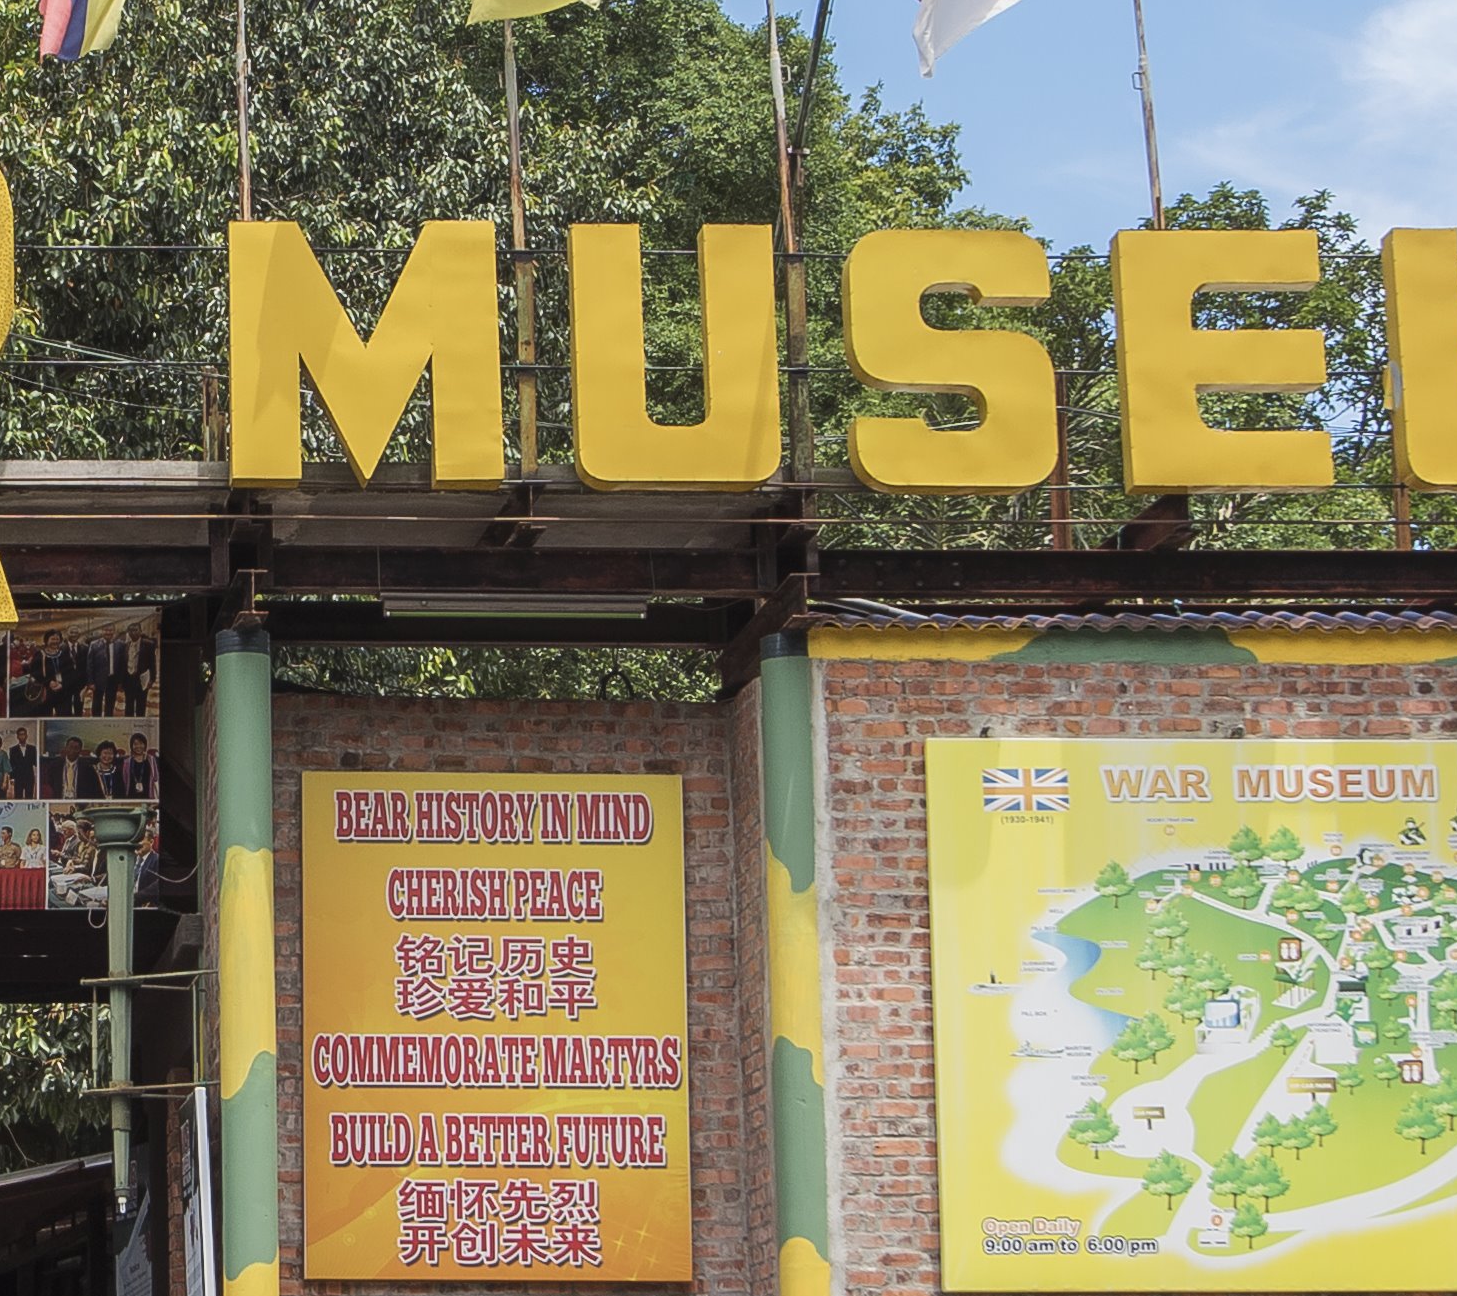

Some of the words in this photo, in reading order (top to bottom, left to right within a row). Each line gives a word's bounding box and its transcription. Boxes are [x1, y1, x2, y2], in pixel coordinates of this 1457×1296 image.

[1100, 766, 1209, 802] WAR
[1233, 765, 1436, 802] MUSEUM
[334, 789, 411, 840] BEAR
[414, 790, 535, 842] HISTORY
[539, 791, 575, 842] IN
[576, 792, 653, 843] MIND
[1000, 815, 1054, 825] (1930-1941)
[387, 868, 508, 920] CHERISH
[512, 869, 604, 920] PEACE
[394, 934, 595, 980] 铭记历史
[395, 976, 598, 1019] 珍爱和平
[312, 1033, 537, 1086] COMMEMORATE
[541, 1035, 682, 1088] MARTYRS
[329, 1112, 414, 1165] BUILD
[417, 1113, 443, 1164] A
[444, 1113, 552, 1165] BETTER
[554, 1114, 667, 1167] FUTURE
[396, 1178, 601, 1223] 缅怀先烈
[396, 1222, 603, 1267] 开创未来
[982, 1218, 1030, 1237] Open
[1032, 1217, 1081, 1238] Daily
[983, 1237, 1023, 1254] 9:00
[1025, 1239, 1055, 1254] am
[1056, 1238, 1079, 1254] to
[1086, 1237, 1128, 1254] 6:00
[1129, 1239, 1160, 1257] pm
